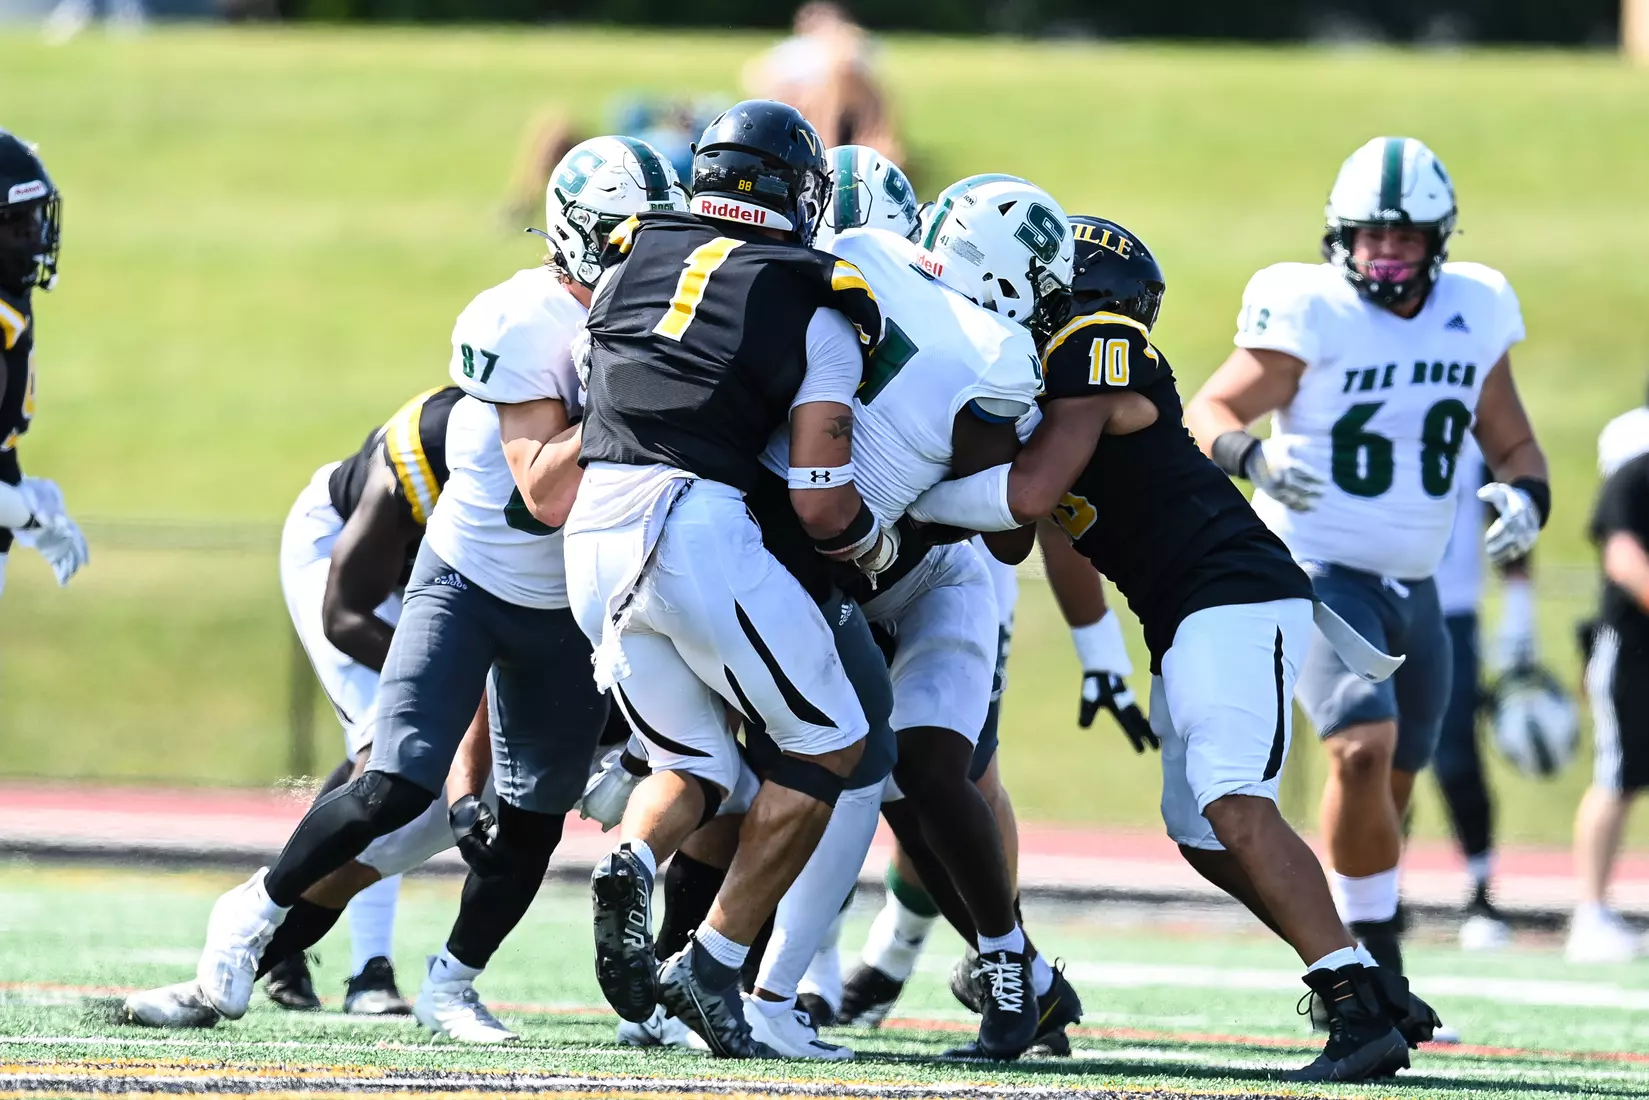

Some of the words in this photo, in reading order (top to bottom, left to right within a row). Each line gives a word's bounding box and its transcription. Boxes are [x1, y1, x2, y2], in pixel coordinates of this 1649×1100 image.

[738, 180, 752, 191] 88
[701, 200, 766, 224] Riddell
[1014, 202, 1067, 264] S
[1068, 222, 1134, 260] ILLE
[652, 236, 747, 342] 1
[460, 342, 500, 385] 87
[1087, 337, 1130, 387] 10
[1342, 366, 1398, 393] THE
[1410, 360, 1476, 388] ROCK
[1330, 397, 1472, 498] 68
[623, 876, 647, 949] POR
